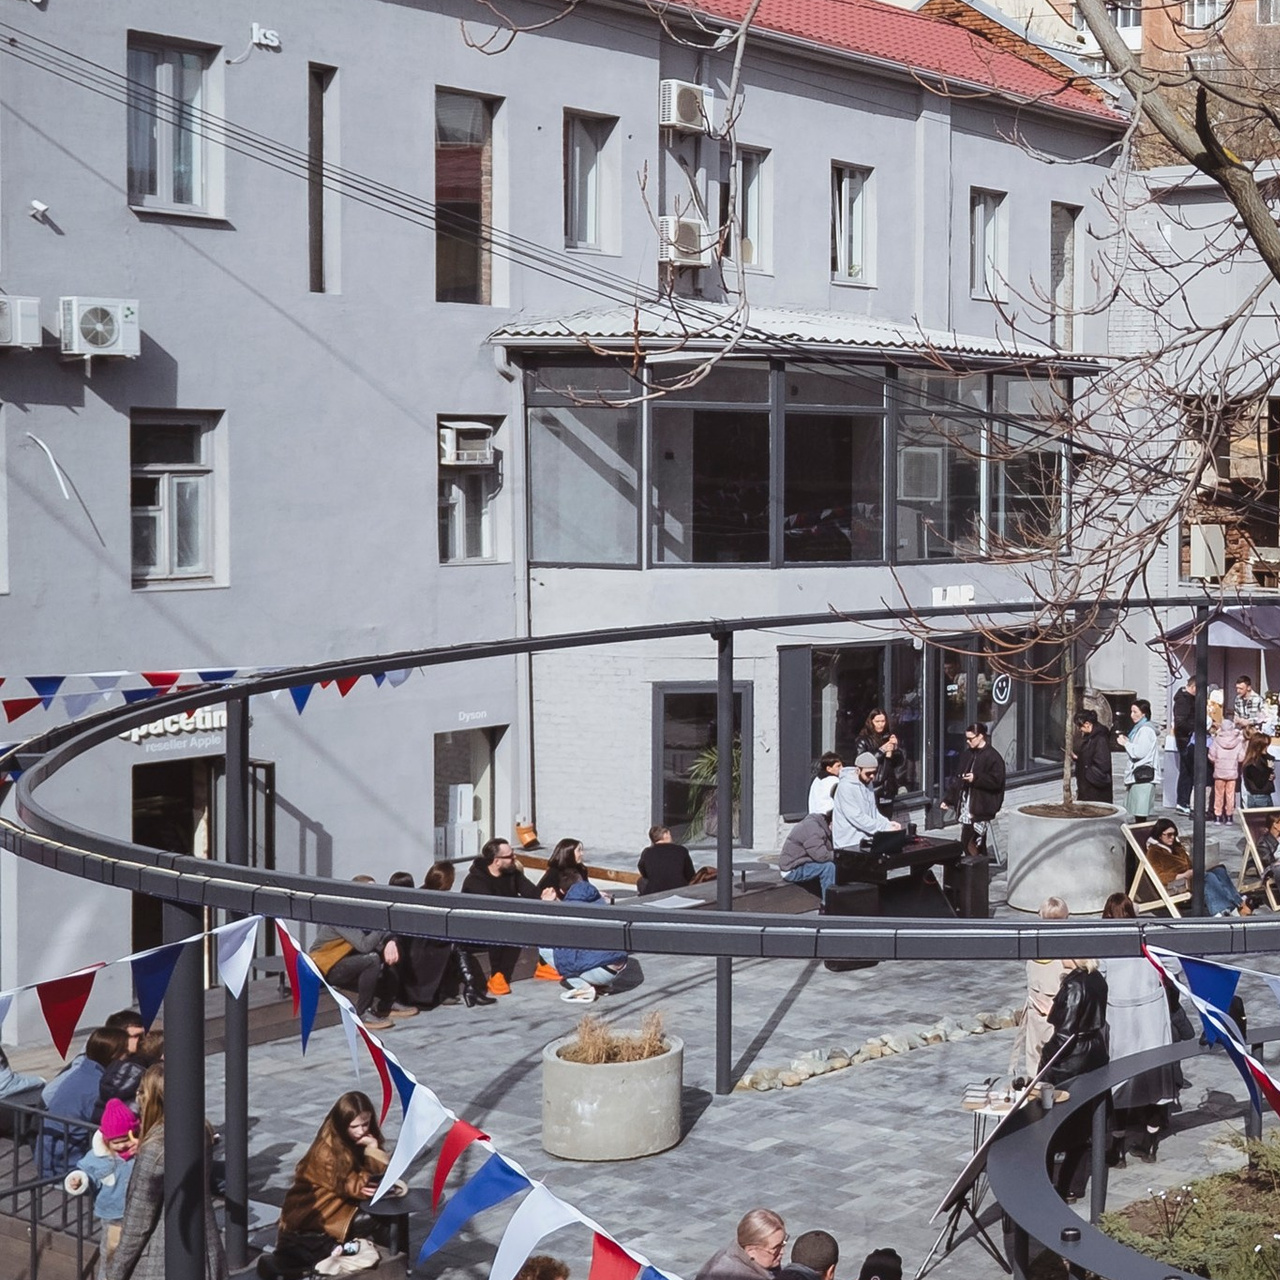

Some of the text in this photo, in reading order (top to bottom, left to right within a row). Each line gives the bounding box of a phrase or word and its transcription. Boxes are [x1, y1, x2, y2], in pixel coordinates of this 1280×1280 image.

[458, 711, 487, 723] Dyson
[145, 734, 222, 753] reseller Apple
